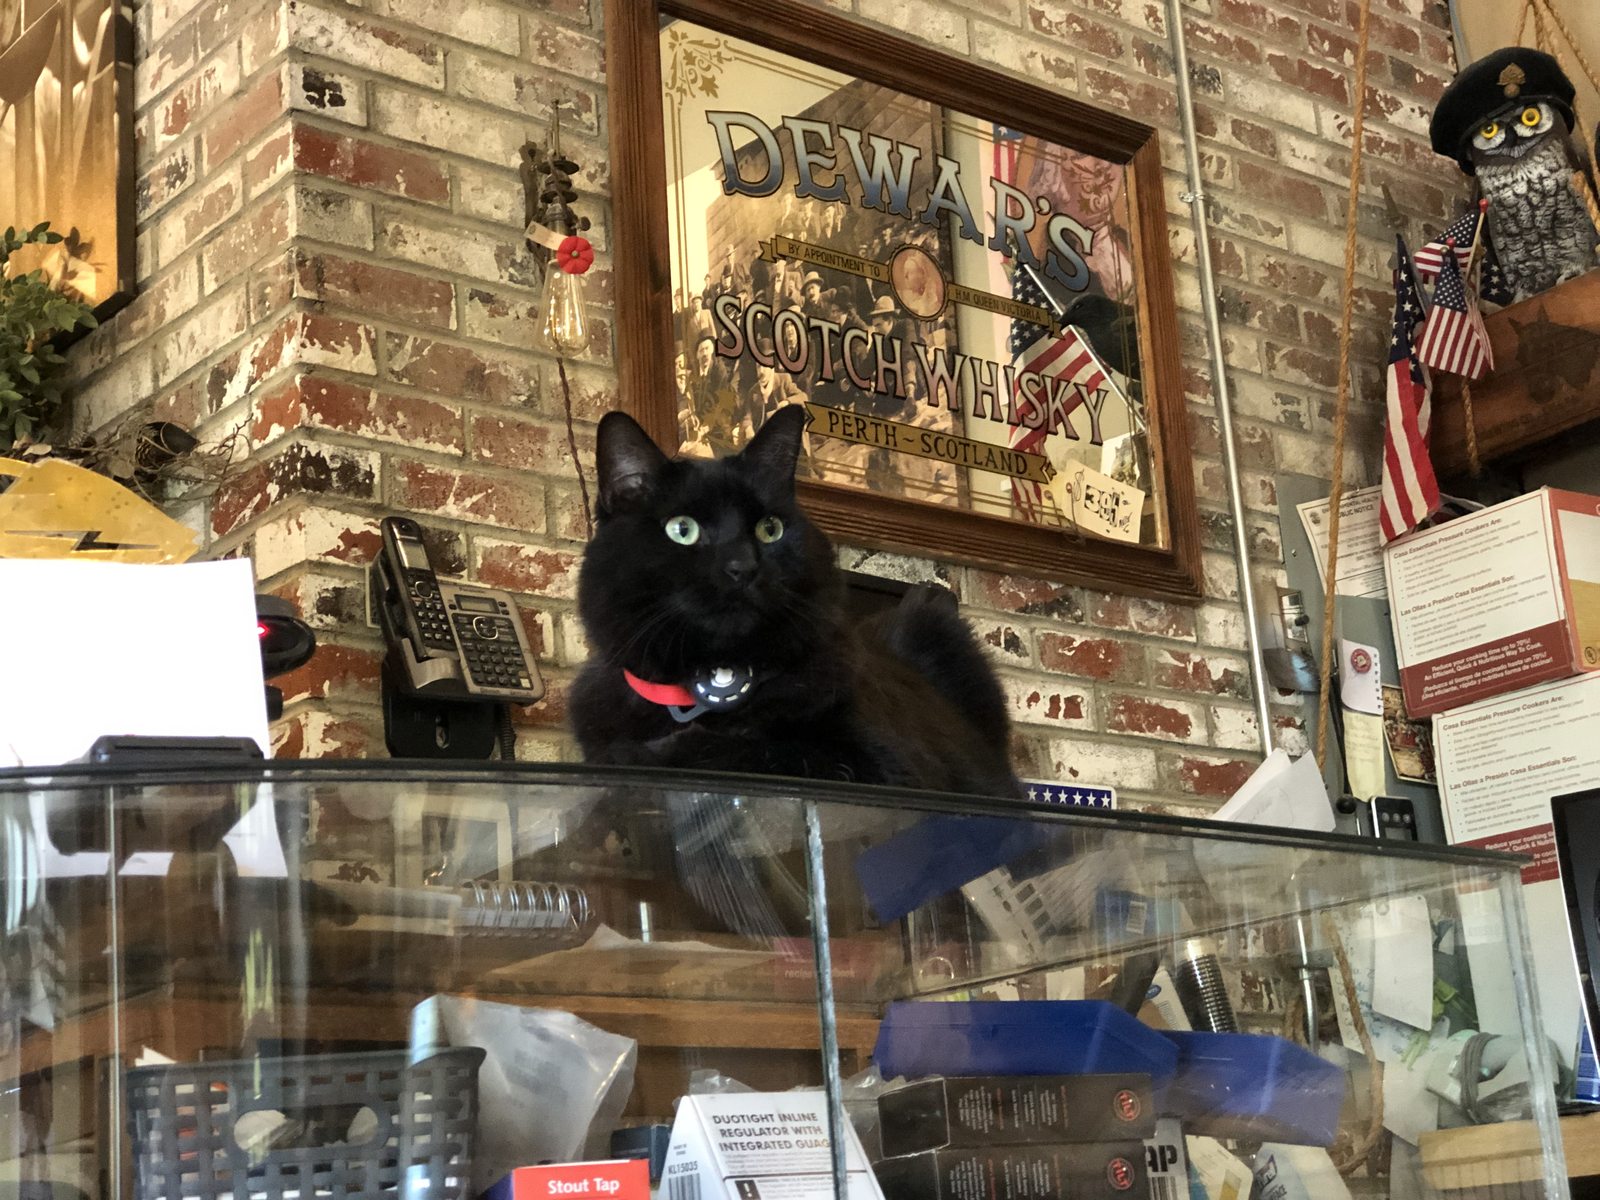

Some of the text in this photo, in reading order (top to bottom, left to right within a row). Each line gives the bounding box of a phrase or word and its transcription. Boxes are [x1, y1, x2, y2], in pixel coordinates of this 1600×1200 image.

[705, 110, 1095, 291] DEWAR'S
[787, 243, 880, 278] BY APPOINTMENT TO
[973, 293, 1001, 310] QUEEN
[1002, 299, 1042, 322] VICTORIA
[713, 294, 1109, 447] SCOTCH WHISKY
[828, 411, 898, 448] PERTH
[1355, 504, 1375, 514] NOTICE
[1394, 550, 1409, 559] Casa
[1409, 540, 1438, 557] Essentials
[1438, 531, 1464, 544] Pressure
[1464, 523, 1490, 535] Cookers
[1401, 606, 1411, 616] Las
[1411, 601, 1428, 612] Ollas
[1432, 593, 1455, 607] Presión
[1455, 588, 1471, 599] Casa
[1471, 579, 1501, 595] Essentials
[1432, 662, 1452, 672] Reduce
[1466, 651, 1488, 663] cooking
[1443, 694, 1565, 731] Casa Essentials Pressure Cookers Are:
[1450, 781, 1462, 791] Las
[1462, 777, 1479, 788] Ollas
[1484, 769, 1509, 782] Presión
[1509, 766, 1527, 776] Casa
[1527, 758, 1561, 772] Essentials
[1561, 754, 1577, 764] Son:
[712, 1112, 818, 1125] DUOTIGHT INLINE
[719, 1126, 823, 1138] REGULATOR WITH
[719, 1137, 830, 1151] INTEGRATED GUAG
[668, 1160, 698, 1175] KL15035
[547, 1177, 620, 1195] Stout Tap
